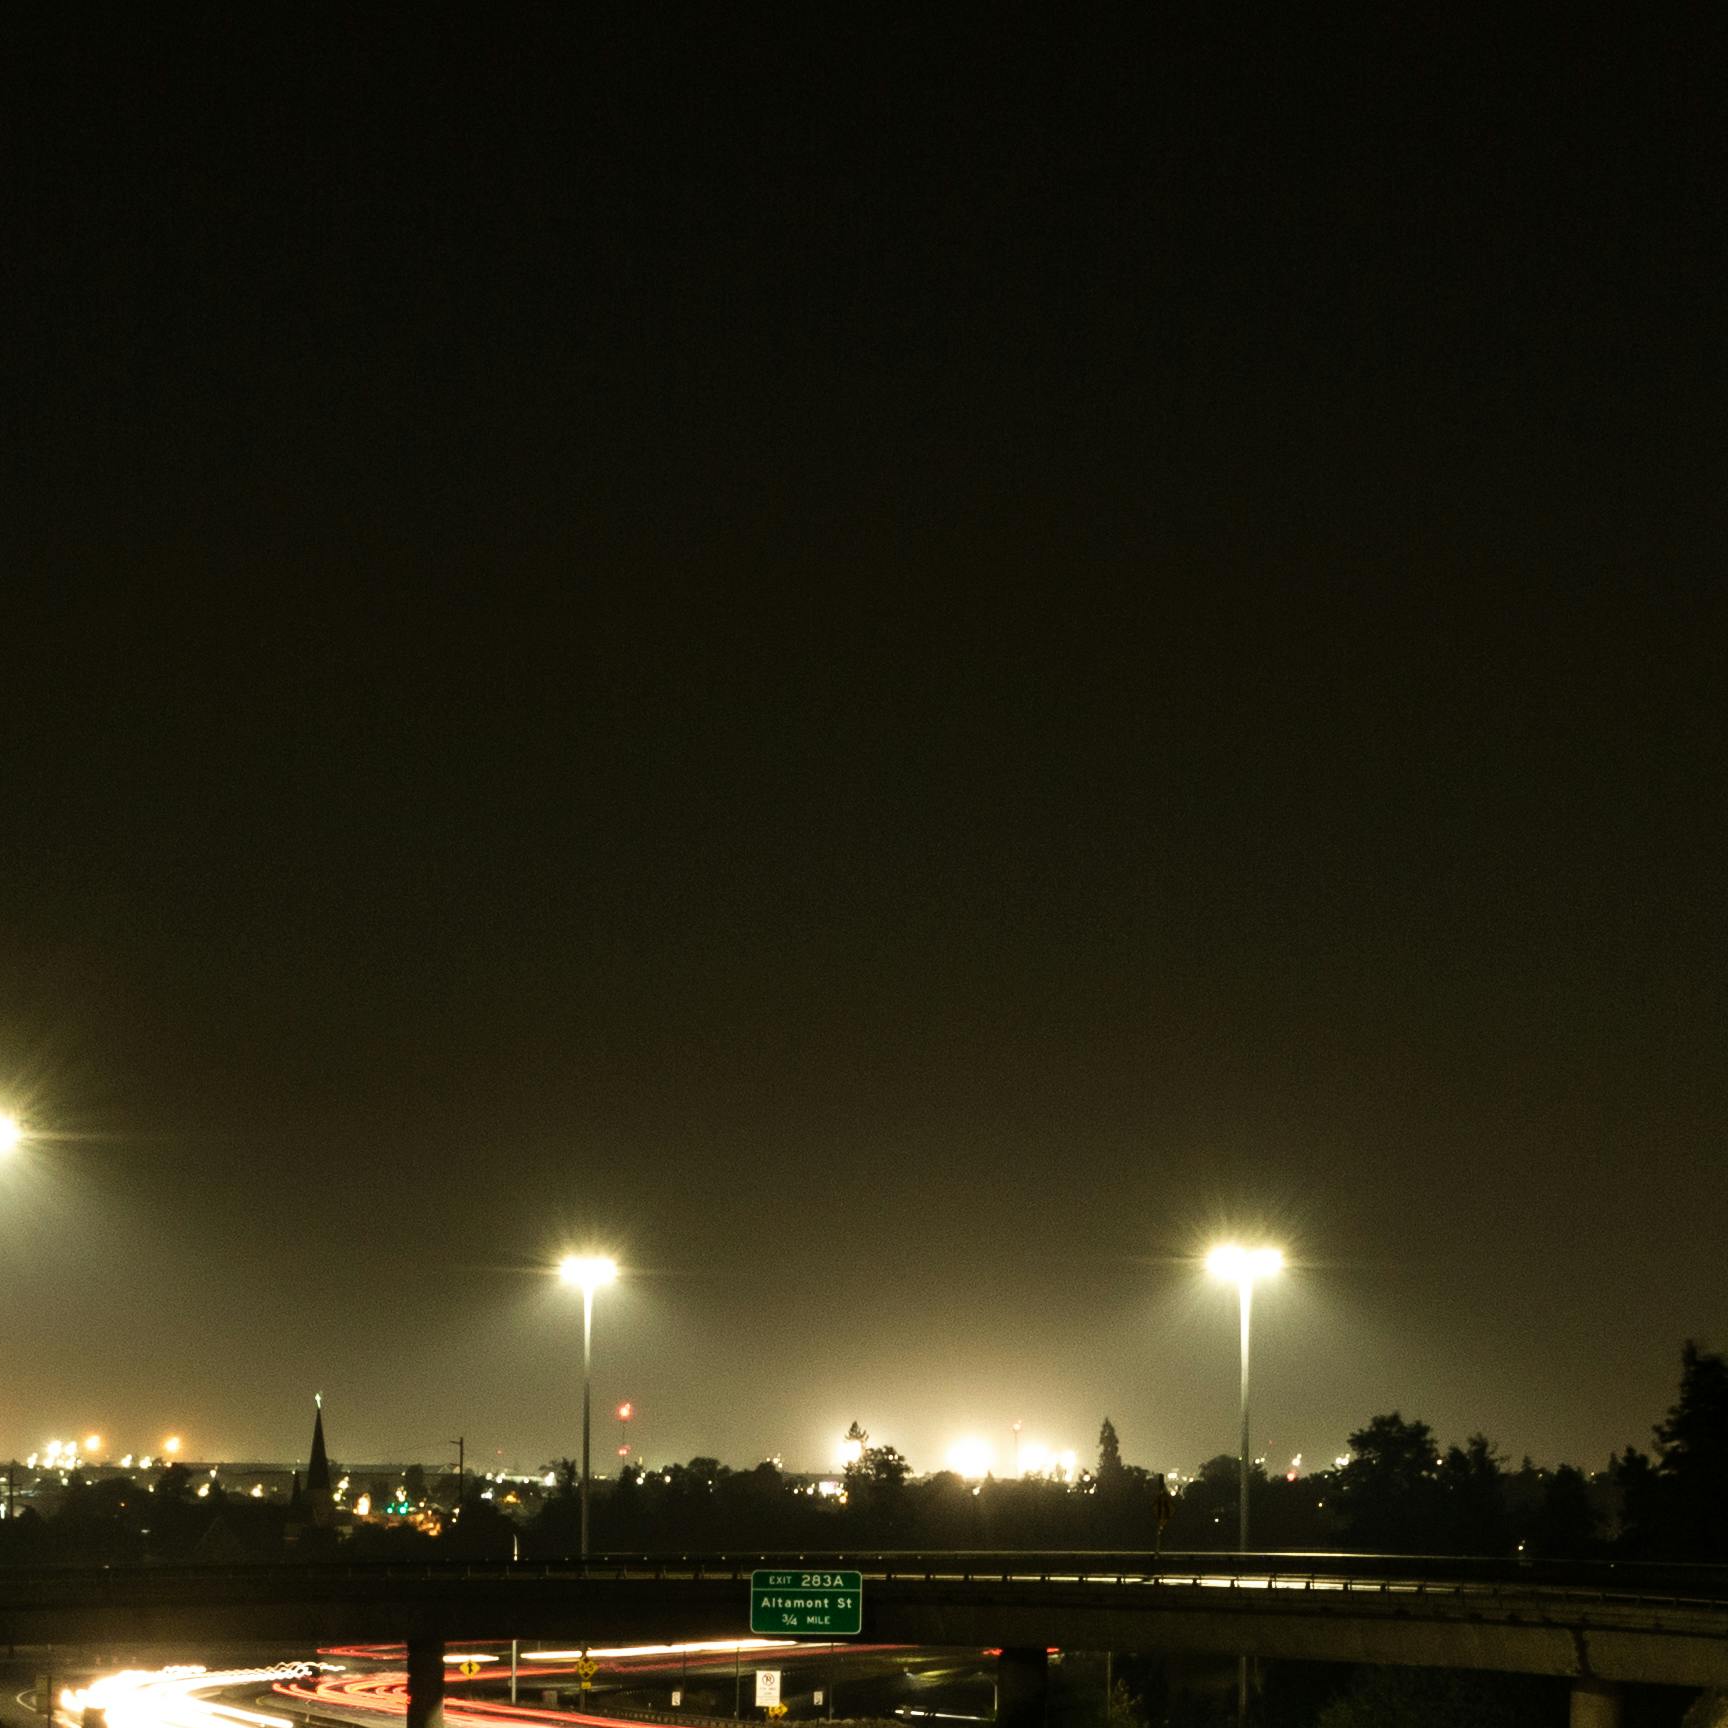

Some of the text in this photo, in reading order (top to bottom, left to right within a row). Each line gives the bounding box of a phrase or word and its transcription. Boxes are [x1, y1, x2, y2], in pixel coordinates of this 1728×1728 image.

[769, 1574, 844, 1587] EXIT 283A
[761, 1597, 852, 1608] Altamont St
[806, 1615, 831, 1625] MILE
